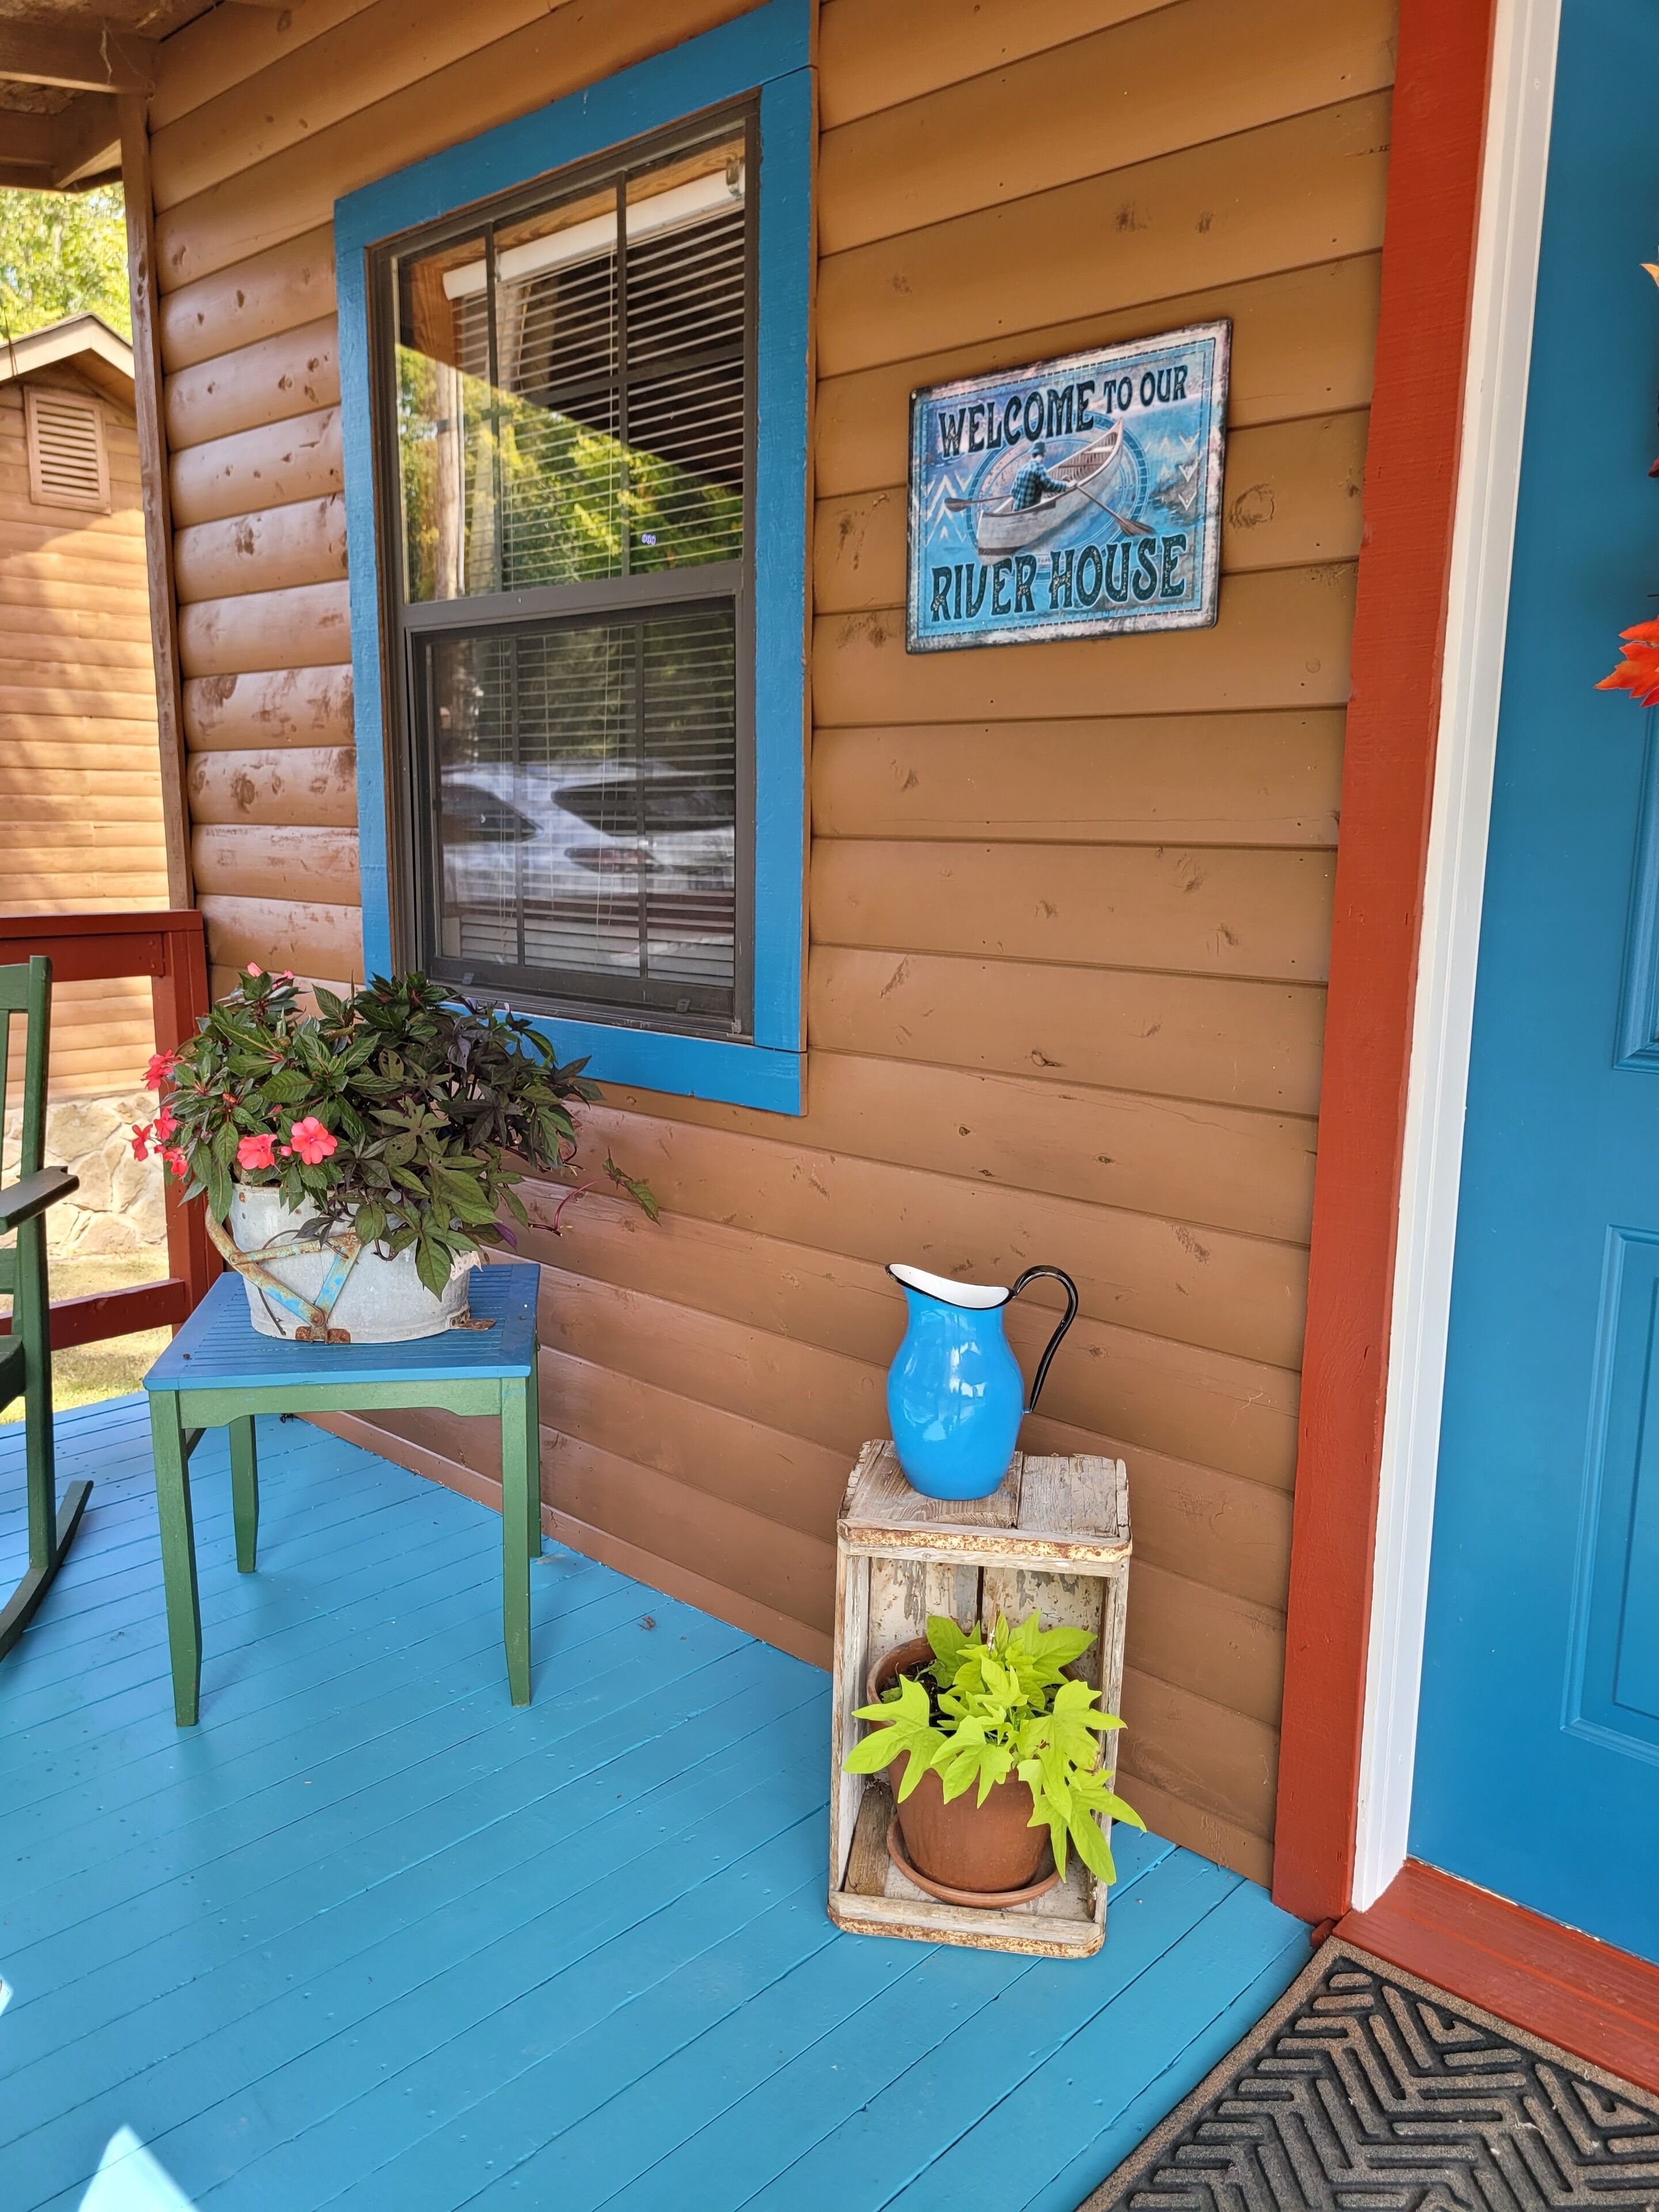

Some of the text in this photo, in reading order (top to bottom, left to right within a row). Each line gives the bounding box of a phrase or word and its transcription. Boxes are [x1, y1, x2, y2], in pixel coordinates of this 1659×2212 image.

[938, 365, 1188, 458] WELCOME TO OUR
[931, 533, 1187, 622] RIVER HOUSE
